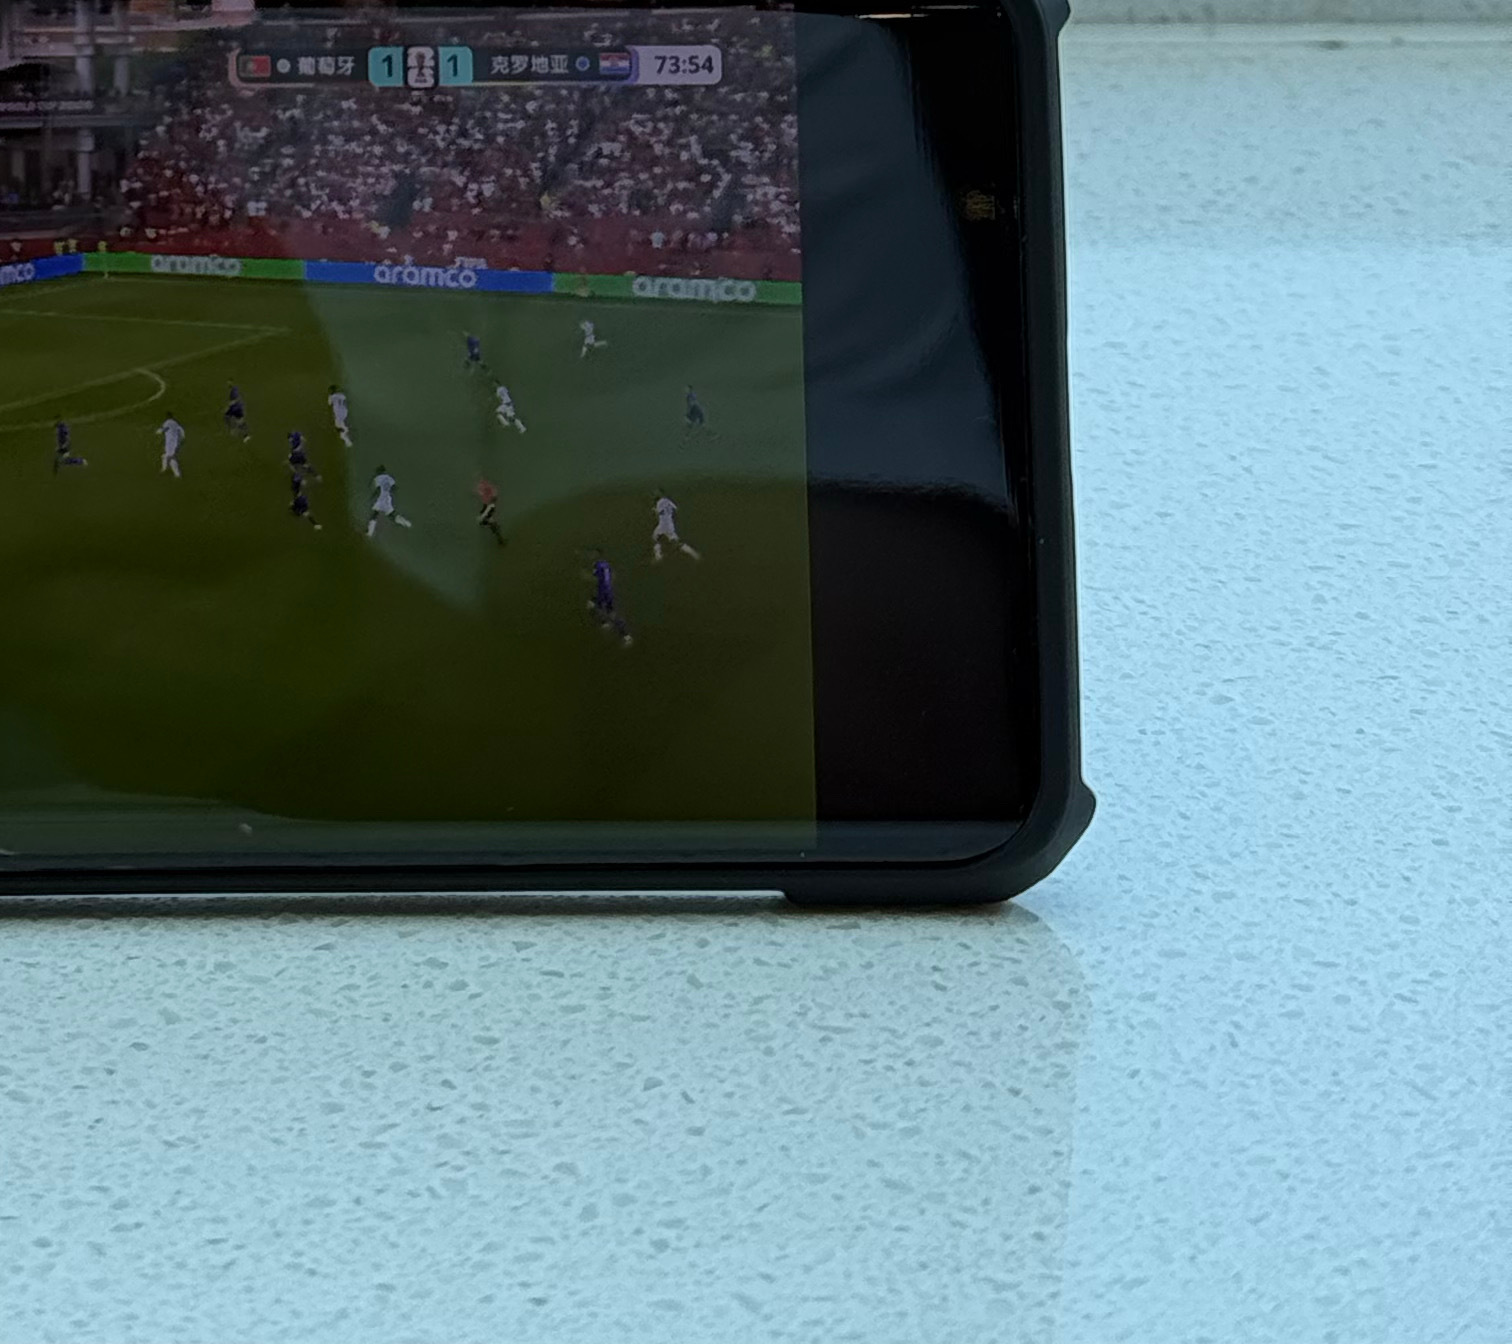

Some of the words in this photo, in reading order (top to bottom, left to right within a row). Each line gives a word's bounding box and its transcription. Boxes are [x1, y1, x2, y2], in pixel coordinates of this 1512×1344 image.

[296, 55, 356, 76] 葡萄牙
[382, 54, 393, 77] 1
[447, 54, 458, 76] 1
[490, 54, 569, 75] 克罗地亚
[654, 54, 714, 75] 73:54
[372, 264, 478, 289] aramco
[631, 275, 758, 303] aramco
